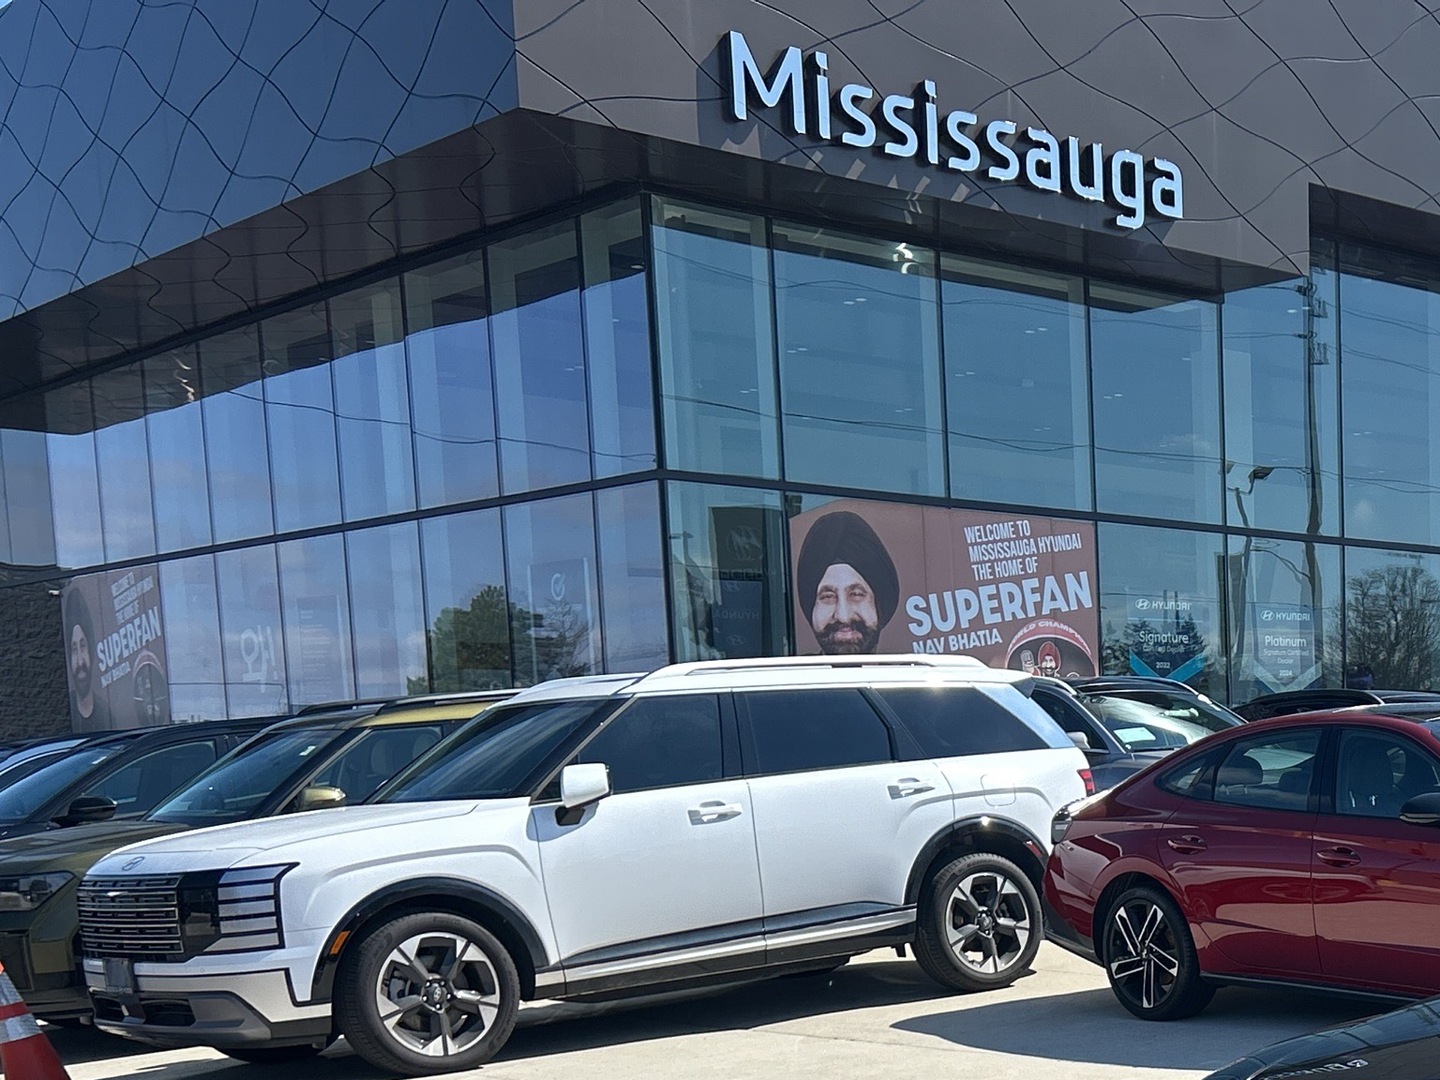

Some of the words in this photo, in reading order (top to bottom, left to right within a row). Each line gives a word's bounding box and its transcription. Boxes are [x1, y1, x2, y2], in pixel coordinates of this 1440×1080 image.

[728, 30, 1184, 229] Mississauga
[963, 521, 1016, 544] WELCOME
[1016, 520, 1031, 537] TO
[968, 538, 1038, 563] MISSISSAUGA
[1037, 533, 1082, 554] HYUNDAI
[971, 562, 993, 581] THE
[994, 559, 1025, 578] HOME
[1025, 556, 1038, 574] OF
[905, 571, 1093, 637] SUPERFAN
[1152, 600, 1192, 611] HYUNDAI
[1275, 612, 1311, 621] HYUNDAI
[97, 606, 161, 672] SUPERFAN
[912, 636, 945, 655] NAV
[948, 628, 1003, 652] BHATIA
[1139, 630, 1189, 645] Signature
[1264, 635, 1307, 647] Platinum
